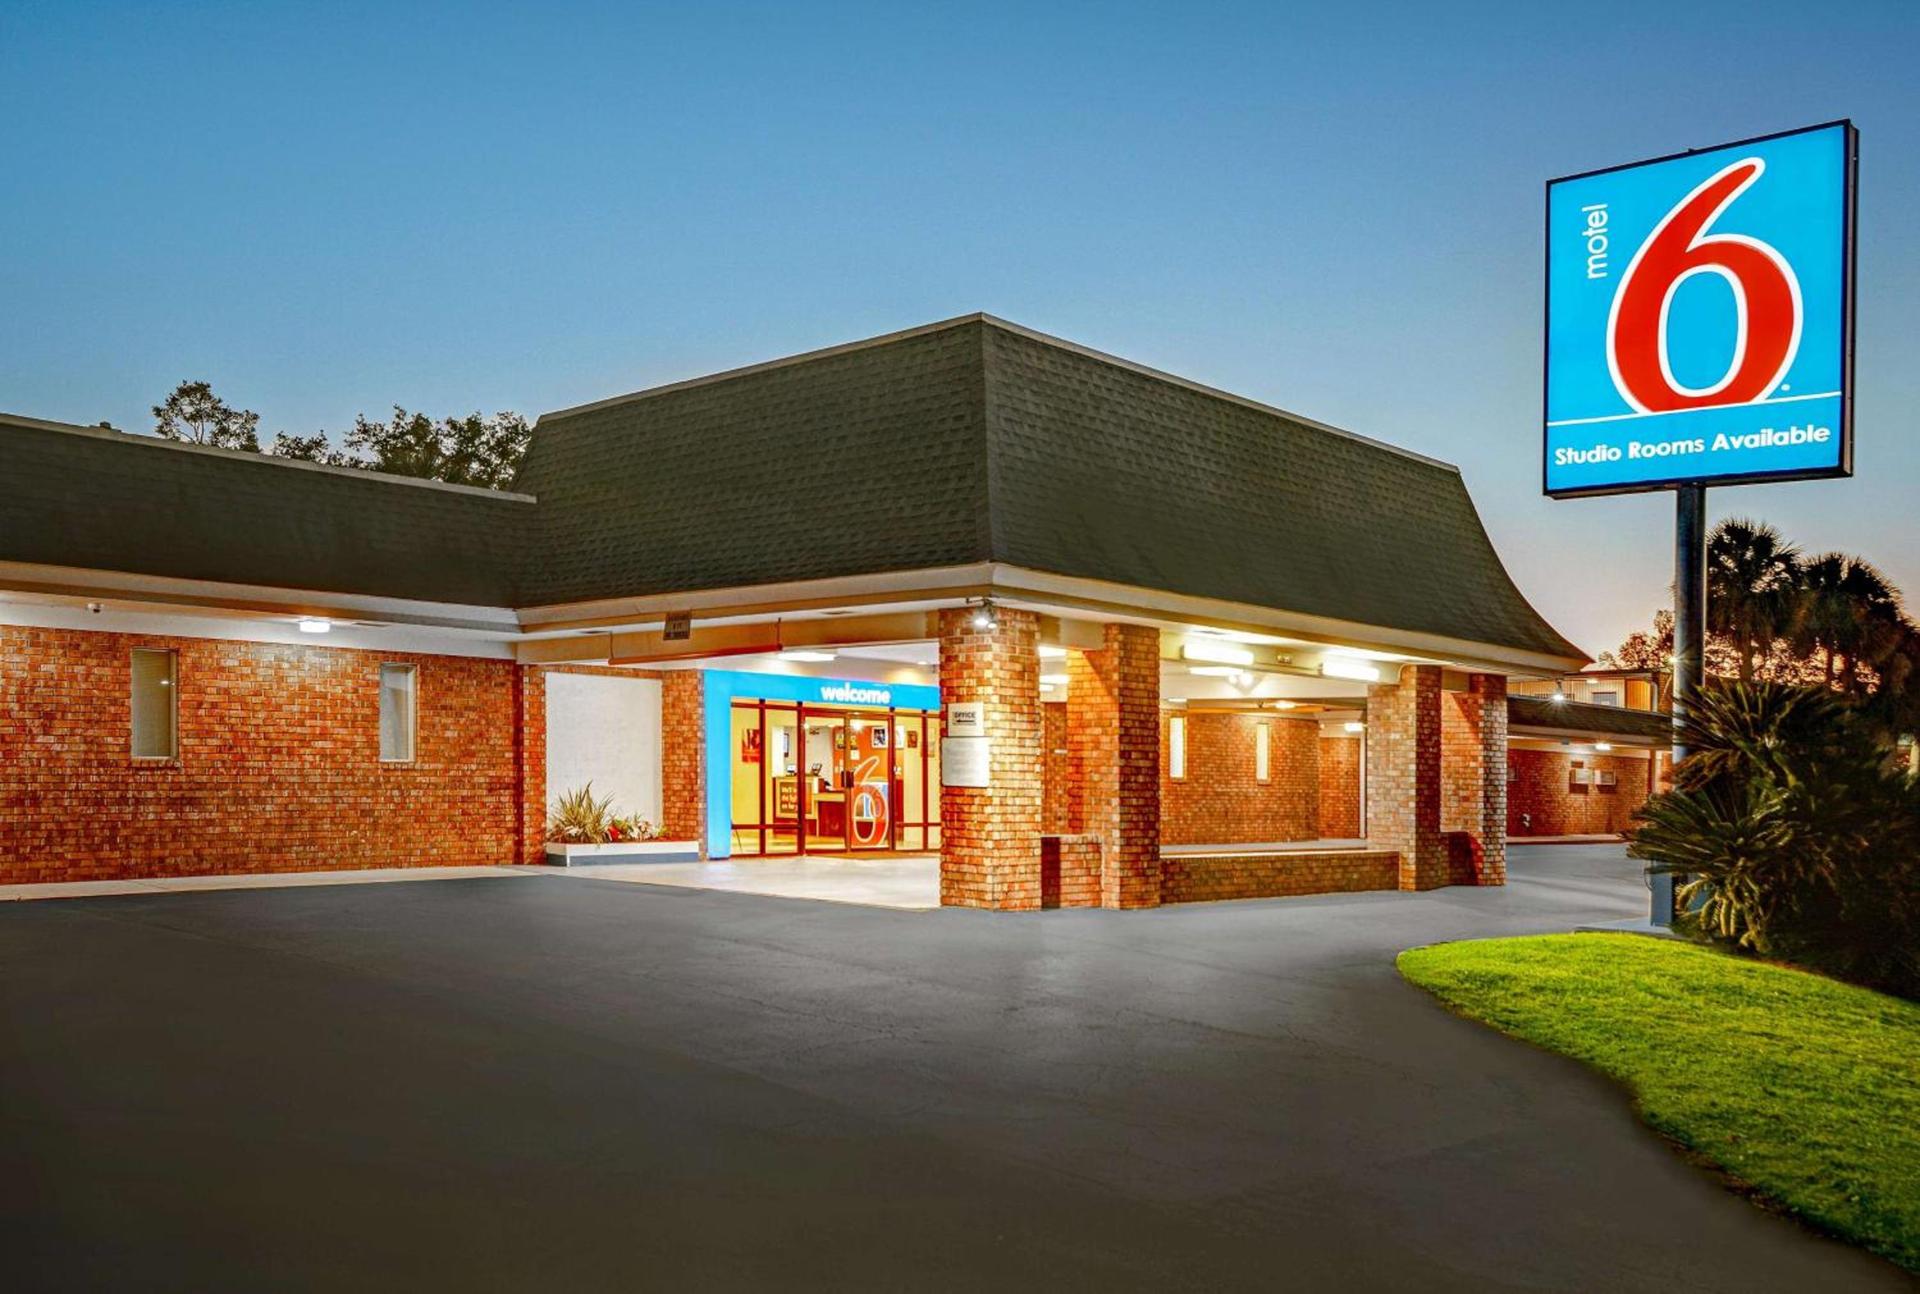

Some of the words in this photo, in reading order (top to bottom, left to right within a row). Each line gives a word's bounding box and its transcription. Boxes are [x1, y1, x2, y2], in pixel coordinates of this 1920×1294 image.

[1581, 204, 1608, 279] motel
[1606, 157, 1803, 414] 6
[1555, 445, 1622, 465] Studio
[1628, 439, 1705, 459] Rooms
[1711, 424, 1831, 451] Available
[820, 682, 891, 704] welcome
[953, 711, 977, 719] OFFICE
